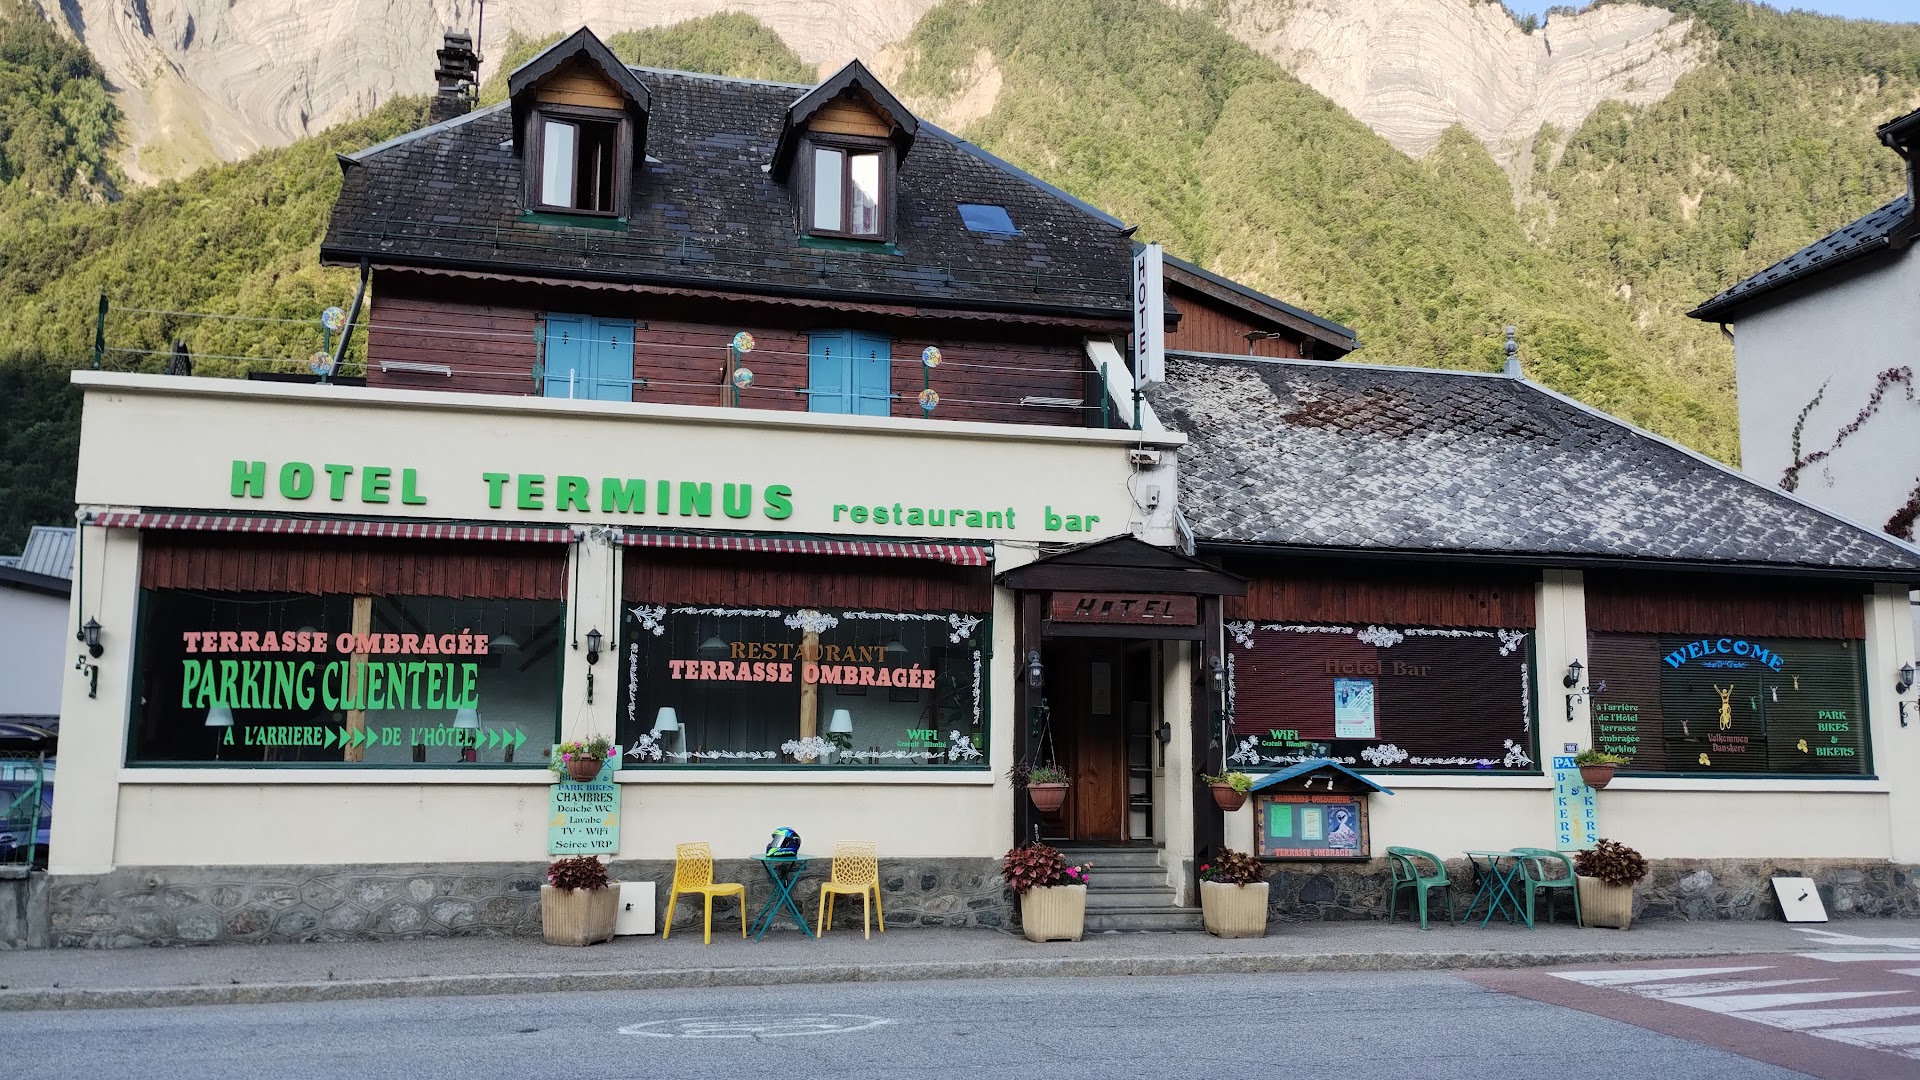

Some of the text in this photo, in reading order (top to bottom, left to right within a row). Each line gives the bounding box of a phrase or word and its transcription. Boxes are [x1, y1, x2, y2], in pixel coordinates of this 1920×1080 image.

[1138, 256, 1147, 381] HOTEL
[229, 459, 793, 520] HOTEL TERMINUS
[833, 502, 1101, 533] restaurant bar
[1074, 598, 1176, 618] HOTEL
[182, 628, 490, 655] TERRASSE OMBRAGÉE
[730, 641, 890, 663] RESTAURANT
[1663, 638, 1785, 673] WELCOME
[1325, 659, 1431, 677] Hotel Bar
[668, 659, 937, 689] TERRASSE OMBRAGÉE
[181, 659, 480, 711] PARKING CLIENTELE
[1596, 703, 1639, 711] à l'arrière
[1598, 713, 1638, 722] de l'Hôtel
[1818, 710, 1847, 720] PARK
[1601, 724, 1637, 732] terrasse
[1817, 722, 1849, 732] BIKES
[244, 726, 323, 746] L'ARRIERE
[381, 727, 402, 746] DE
[411, 722, 474, 747] L'HÔTEL
[906, 728, 938, 741] WiFi
[1269, 729, 1299, 741] WiFi
[1599, 734, 1640, 744] ombragée
[1830, 736, 1838, 744] &
[1604, 744, 1637, 754] Parking
[1816, 747, 1855, 757] BIKERS
[556, 792, 613, 803] CHAMBRES
[557, 804, 613, 813] Douche WC
[1556, 772, 1570, 843] BIKERS
[569, 816, 602, 824] Lavabo
[561, 827, 608, 836] TV WiFi
[590, 840, 613, 848] VRP
